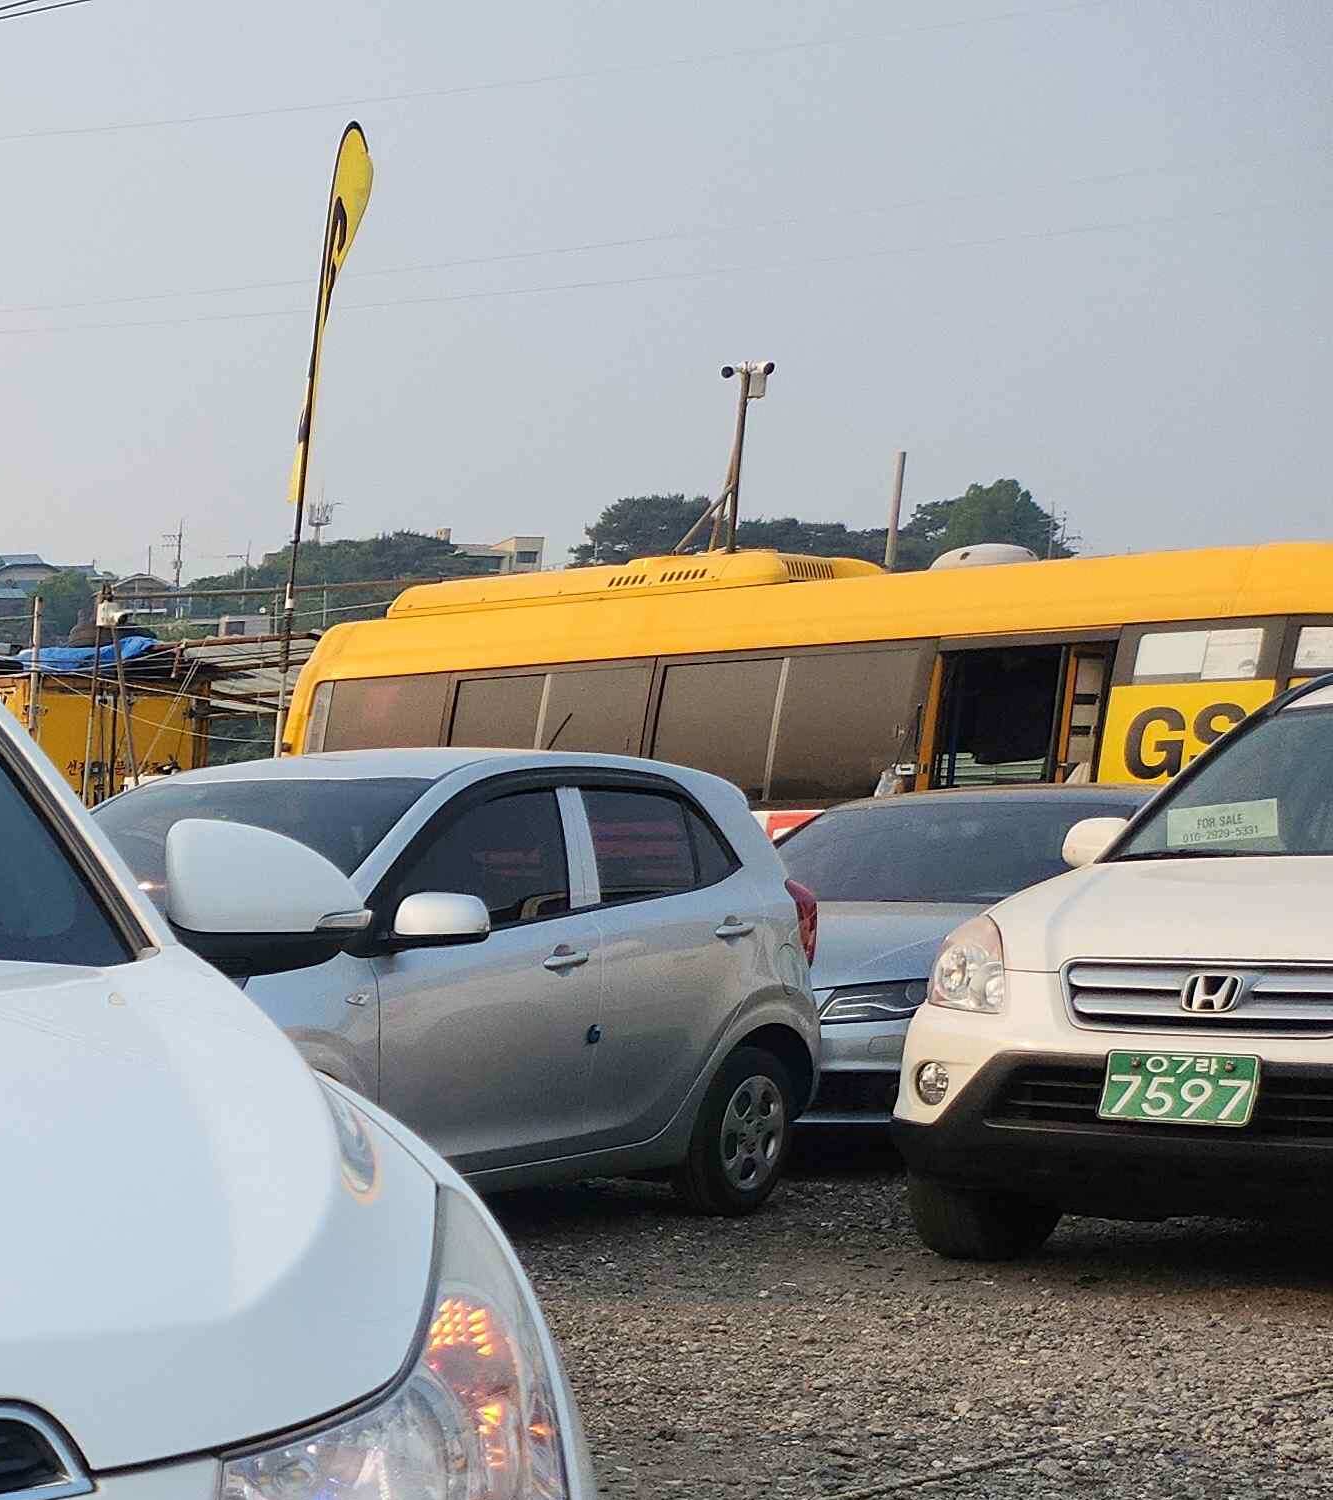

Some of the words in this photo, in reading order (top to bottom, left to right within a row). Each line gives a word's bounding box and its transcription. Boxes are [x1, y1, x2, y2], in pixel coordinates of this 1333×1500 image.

[1196, 817, 1215, 829] FOR
[1219, 813, 1244, 826] SALE
[1146, 1056, 1219, 1075] 07라
[1110, 1074, 1252, 1119] 7597
